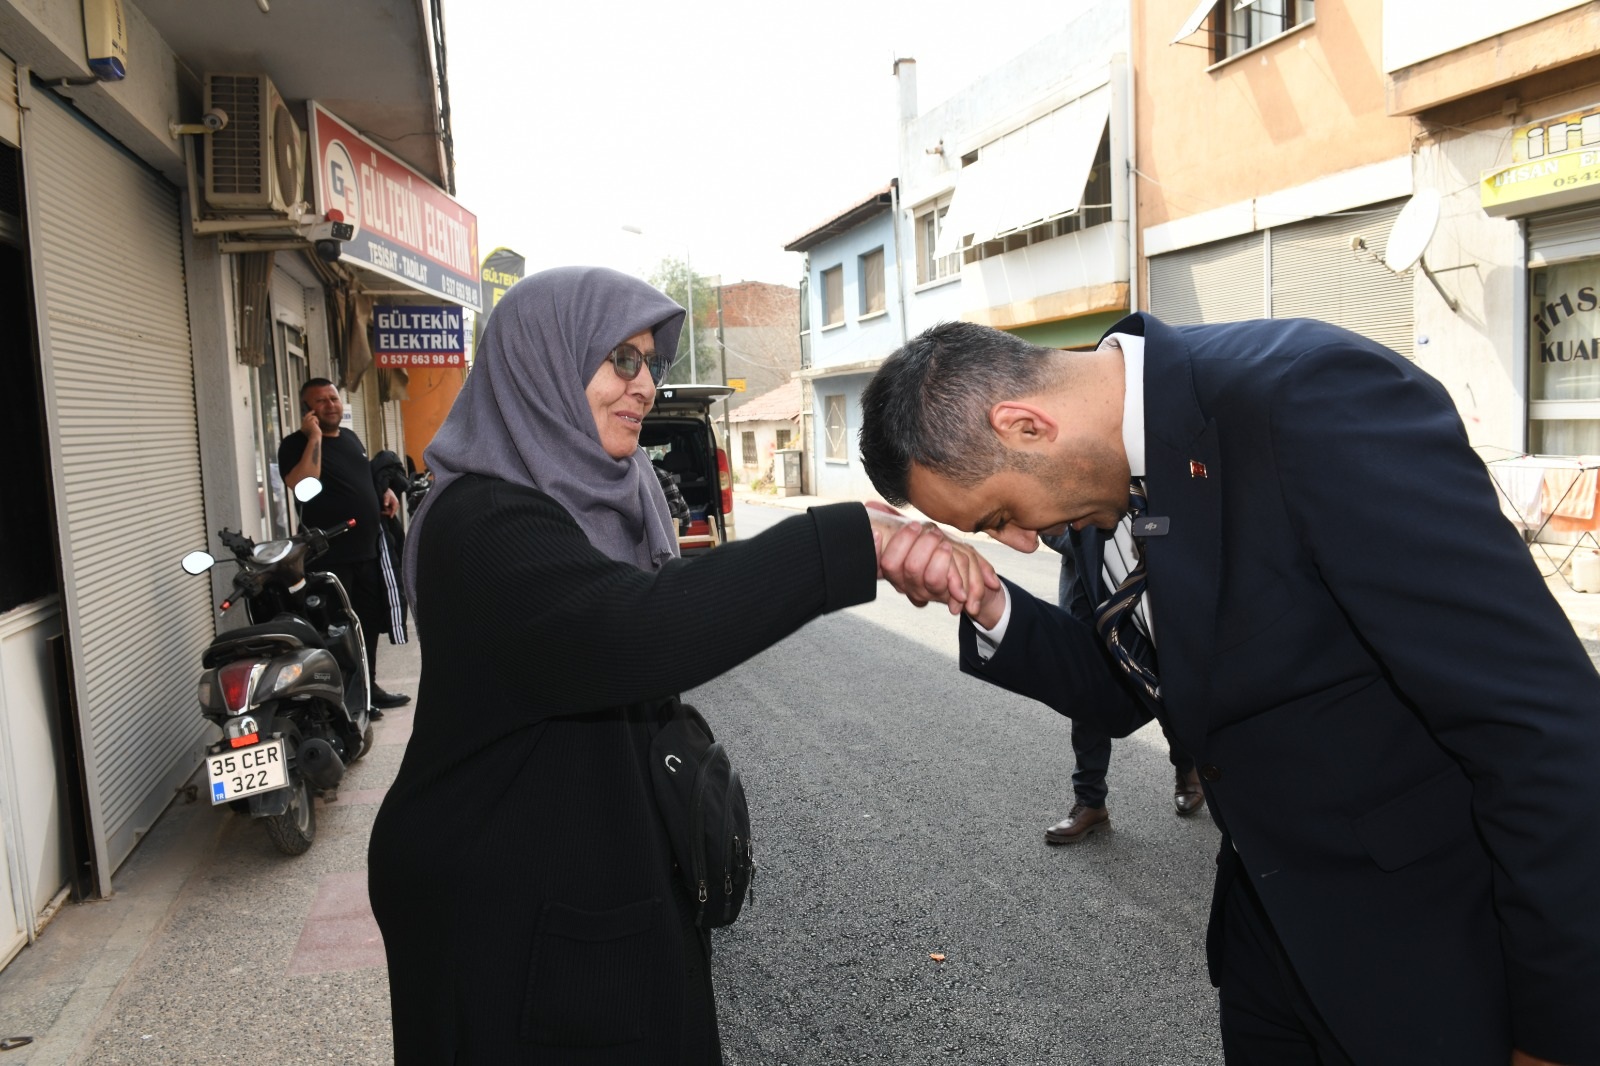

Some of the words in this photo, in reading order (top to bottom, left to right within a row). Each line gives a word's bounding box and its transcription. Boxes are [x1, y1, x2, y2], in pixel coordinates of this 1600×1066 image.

[1578, 150, 1600, 169] E
[360, 152, 423, 251] GÜLTEKİN
[424, 201, 471, 275] ELEKTRİK
[368, 240, 398, 272] TESİSAT
[402, 255, 428, 284] TADİLAT
[446, 275, 455, 294] 537
[378, 310, 460, 330] GÜLTEKİN
[379, 331, 460, 350] ELEKTRİK
[381, 355, 387, 365] 0
[390, 355, 408, 365] 537
[411, 355, 430, 365] 663
[433, 355, 445, 365] 98
[447, 355, 460, 365] 49
[212, 756, 236, 776] 35
[241, 746, 279, 769] CER
[232, 770, 269, 793] 322
